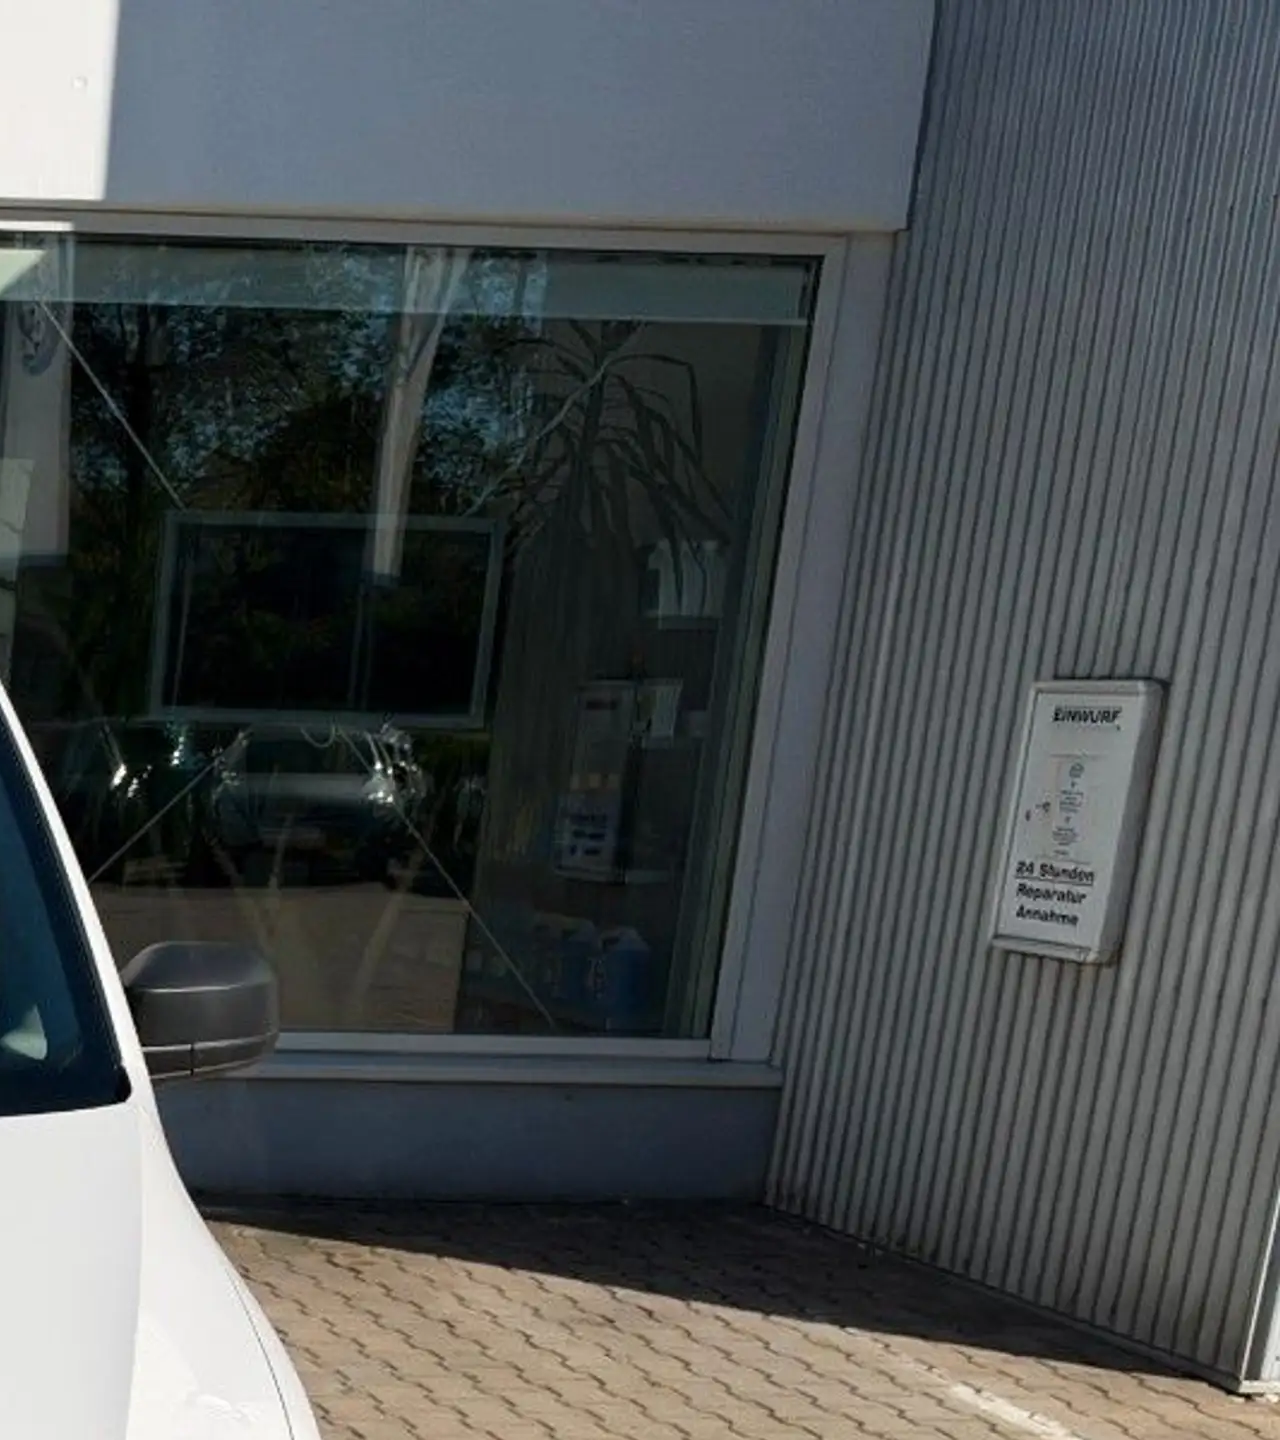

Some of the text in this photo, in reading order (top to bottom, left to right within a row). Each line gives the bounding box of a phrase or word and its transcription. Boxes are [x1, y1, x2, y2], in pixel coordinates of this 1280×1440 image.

[1052, 707, 1123, 724] EINWURF
[1015, 861, 1095, 883] 24 Stunden
[1016, 883, 1087, 904] Reparatur
[1015, 904, 1079, 926] Annahme
